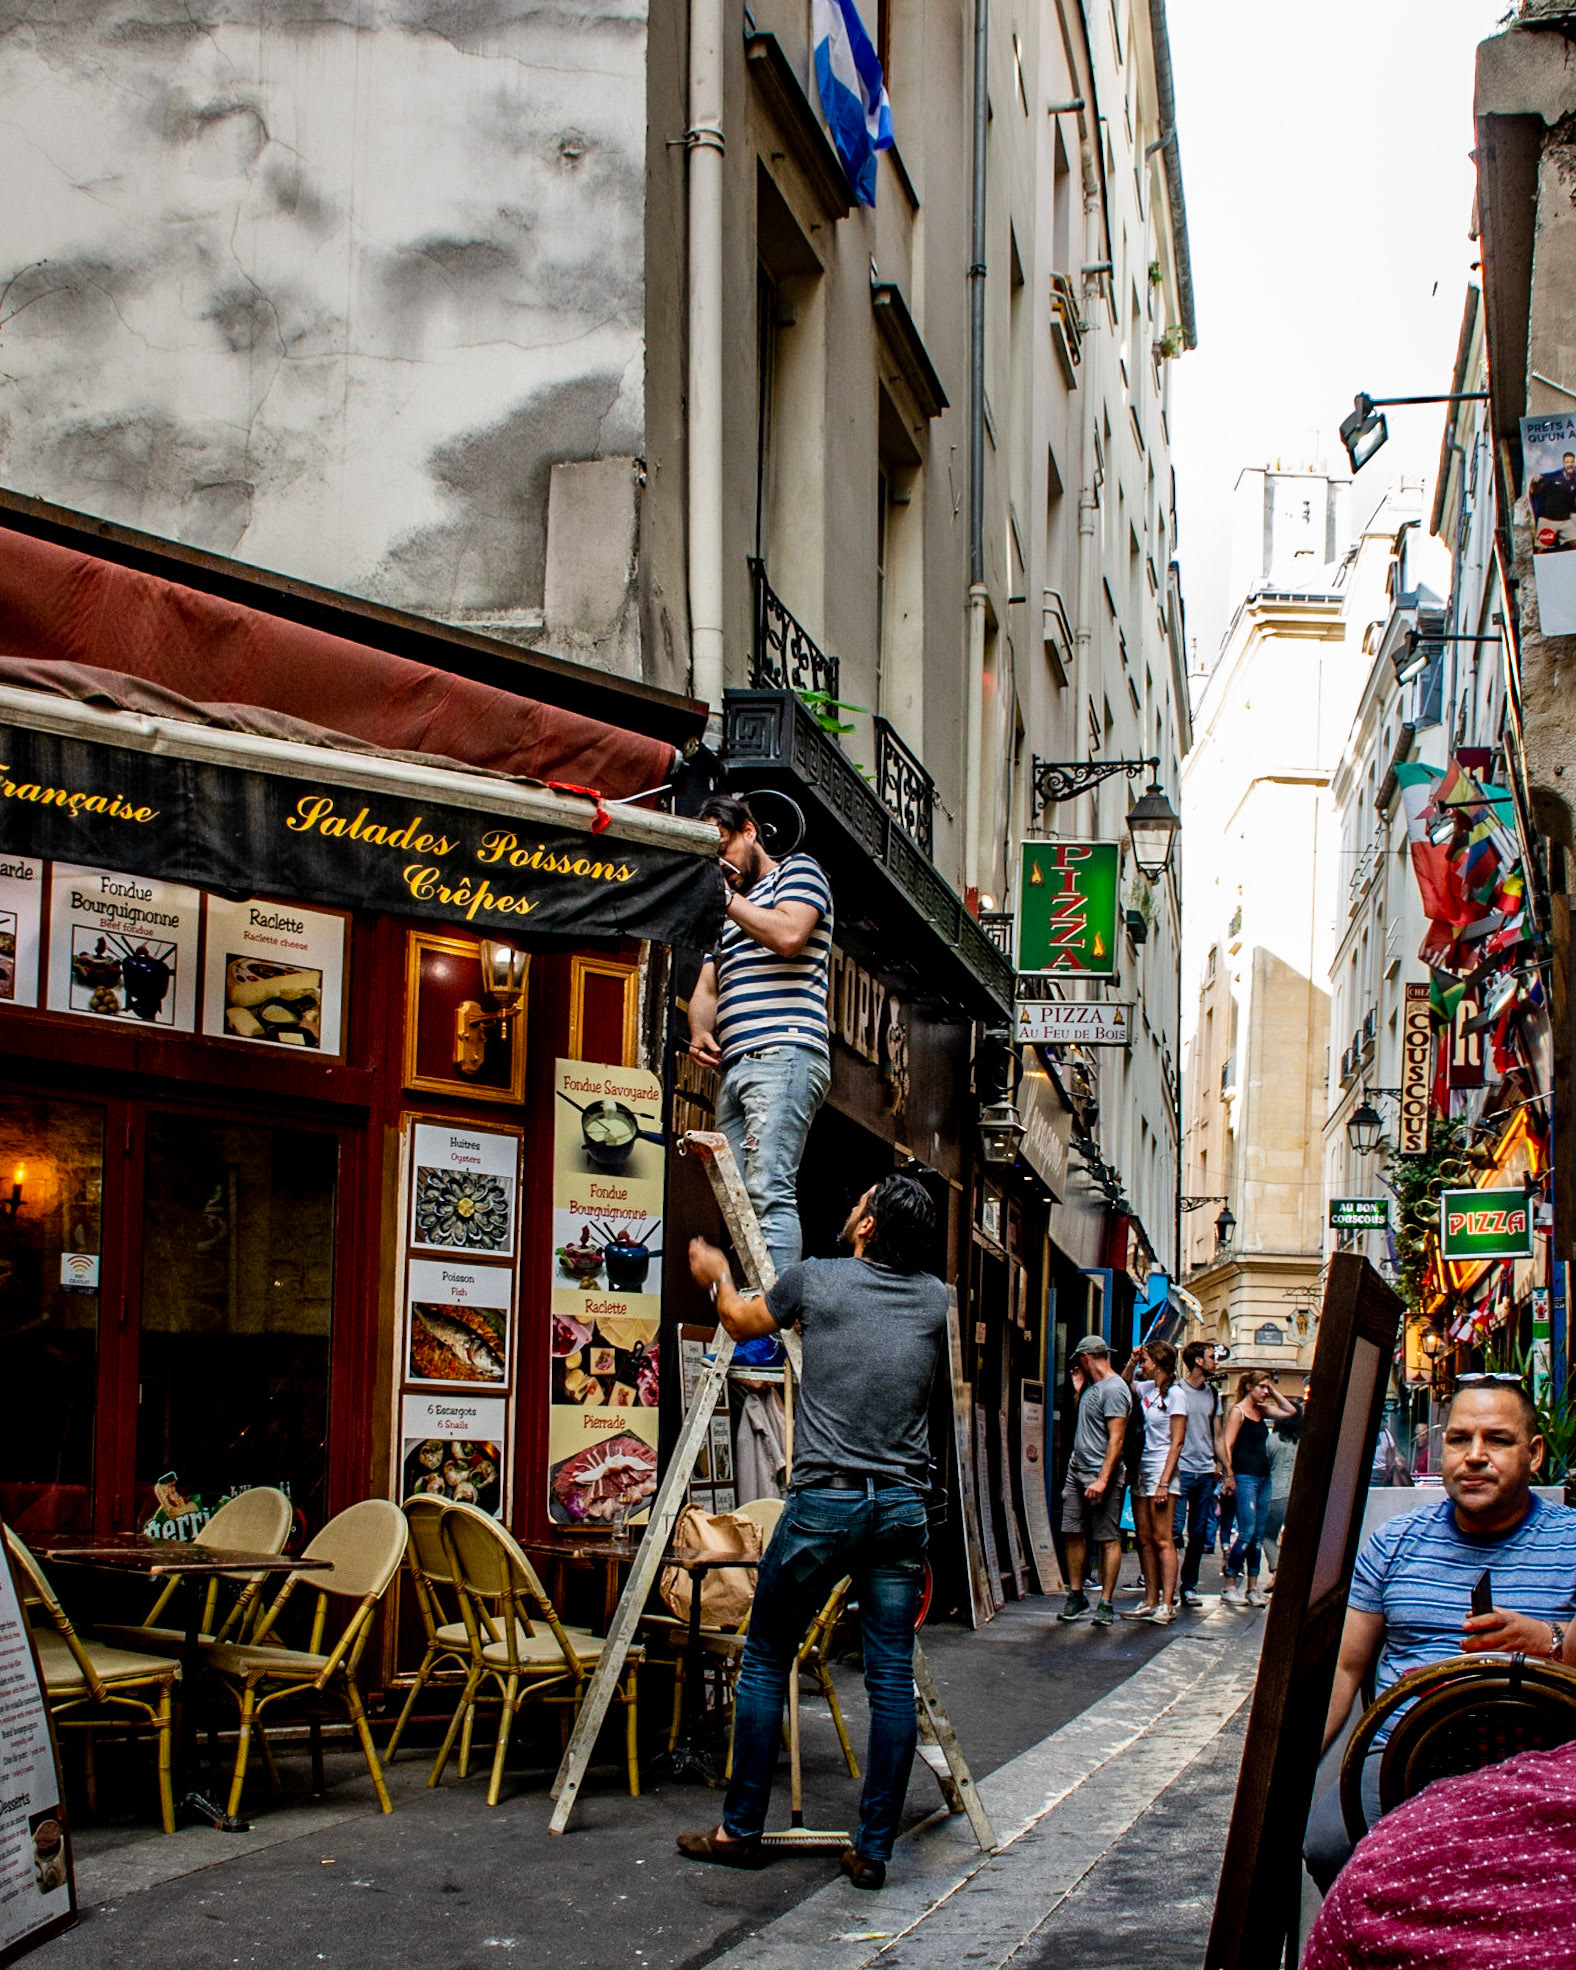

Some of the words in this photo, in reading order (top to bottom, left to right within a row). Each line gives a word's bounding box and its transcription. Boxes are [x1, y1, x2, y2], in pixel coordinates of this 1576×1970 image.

[1528, 431, 1565, 443] QU'UN
[286, 795, 460, 856] Salades
[476, 829, 639, 882] Poissons
[100, 876, 153, 902] Fondue
[403, 864, 540, 920] Crêpes
[70, 891, 180, 928] Bourguignonne
[1040, 845, 1092, 972] PIZZA
[123, 920, 154, 936] fondue
[249, 908, 304, 934] Raclette
[243, 930, 279, 945] Raclette
[1040, 1007, 1105, 1024] PIZZA
[563, 1075, 602, 1094] Fondue
[604, 1079, 659, 1102] Savoyarde
[1403, 1013, 1430, 1151] COUSCOUS
[451, 1152, 481, 1164] Oysters
[590, 1183, 628, 1200] Fondue
[569, 1200, 647, 1222] Bourguignonne
[1356, 1203, 1377, 1213] BON
[1331, 1214, 1385, 1225] COUSCOUS
[1448, 1210, 1526, 1236] PIZZA
[442, 1271, 475, 1284] Poisson
[451, 1287, 468, 1297] Fish
[585, 1298, 627, 1315] Raclette
[427, 1404, 434, 1415] 6
[435, 1404, 477, 1419] Escargots
[437, 1419, 443, 1429] 6
[445, 1419, 469, 1430] Snails
[583, 1414, 626, 1429] Pierrade
